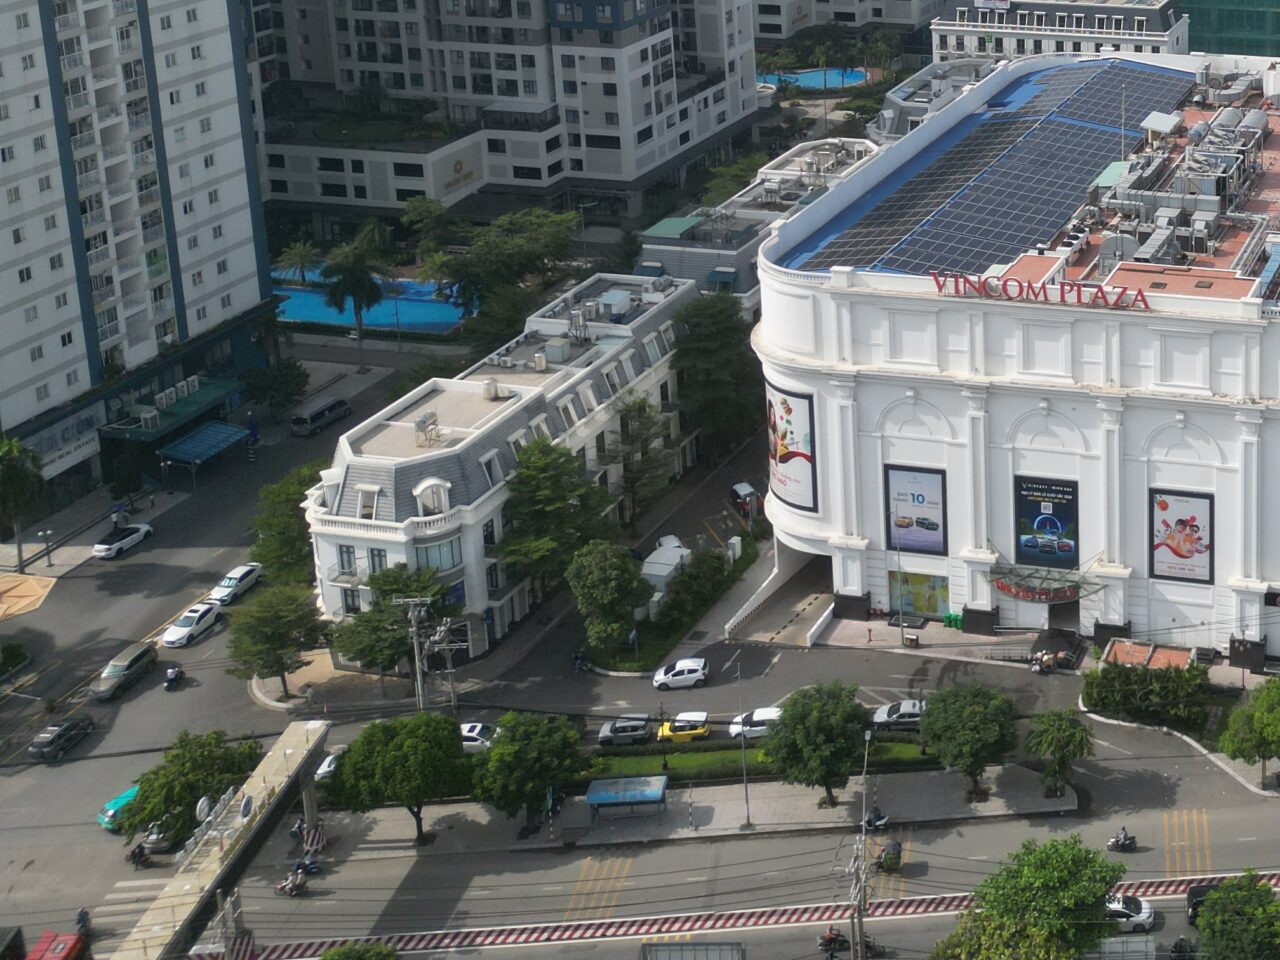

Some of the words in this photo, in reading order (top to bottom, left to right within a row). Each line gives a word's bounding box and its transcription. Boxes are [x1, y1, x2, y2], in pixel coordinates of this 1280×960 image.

[929, 271, 1050, 303] VINCOM
[1059, 281, 1150, 310] PLAZA
[910, 492, 926, 505] 10
